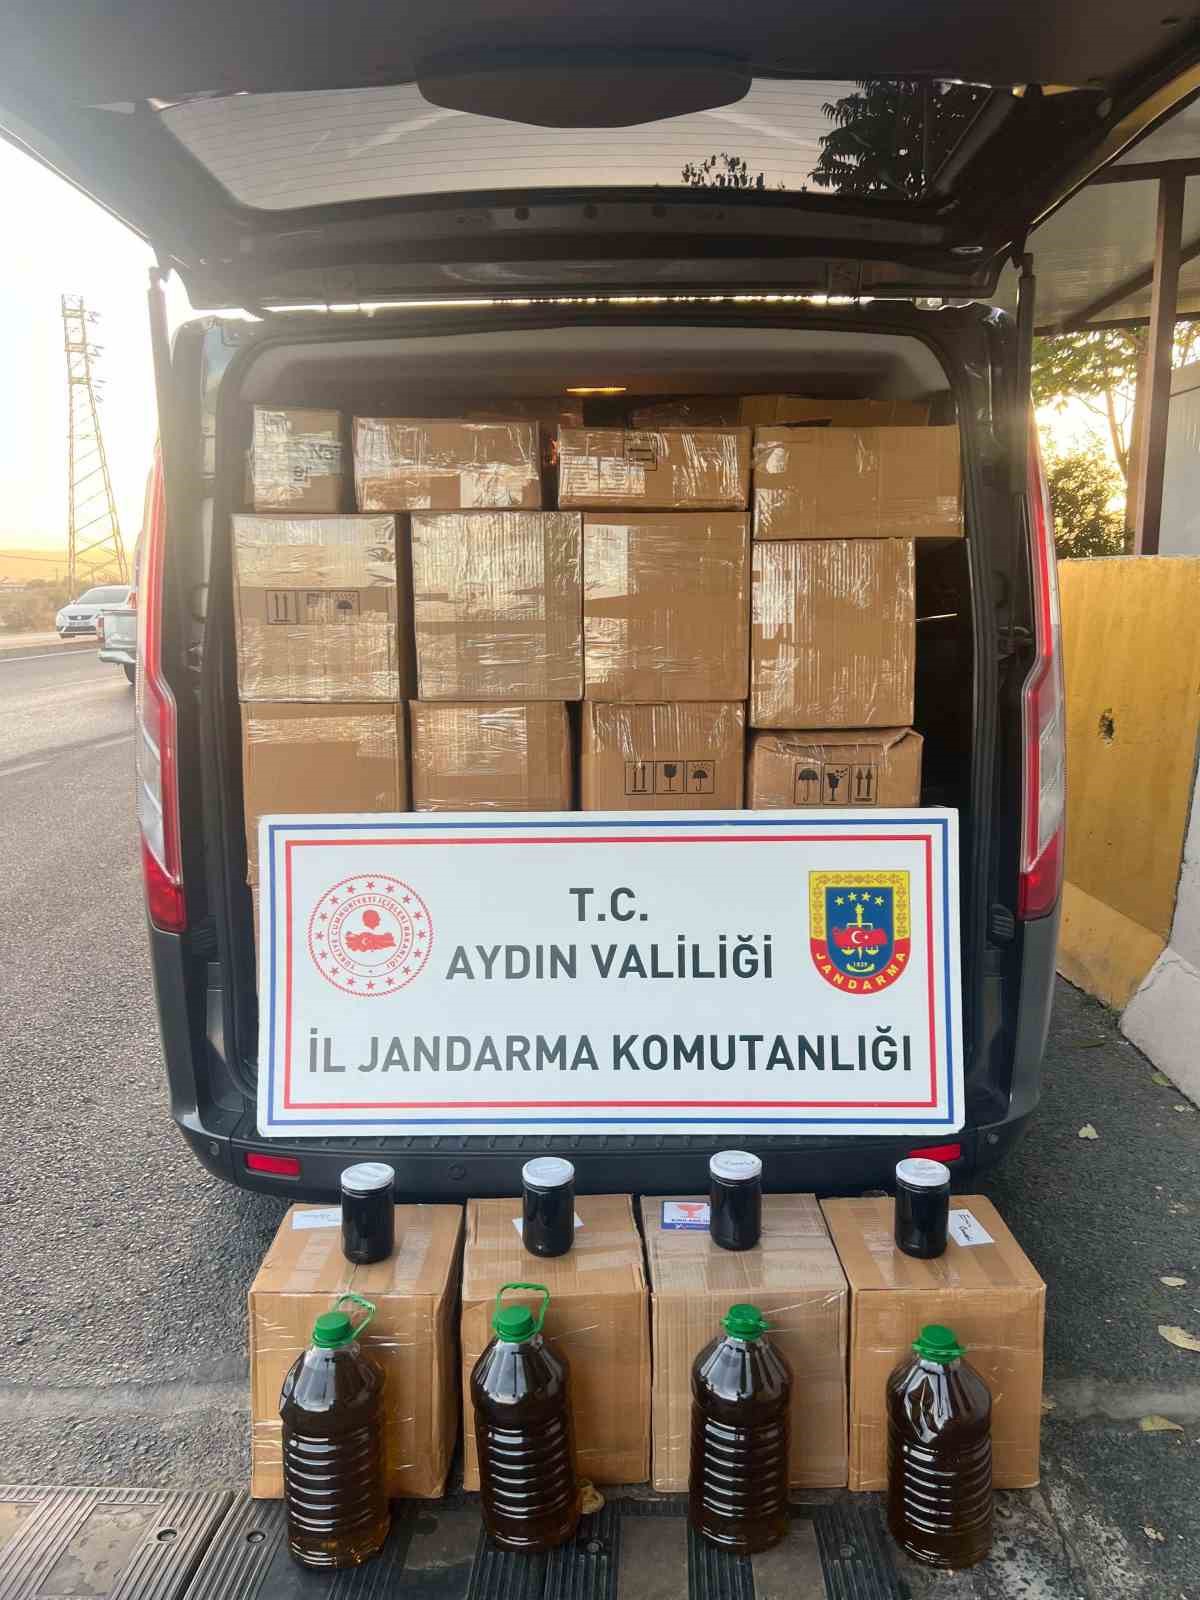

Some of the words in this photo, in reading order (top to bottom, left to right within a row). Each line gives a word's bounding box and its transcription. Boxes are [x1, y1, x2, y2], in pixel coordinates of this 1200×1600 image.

[569, 887, 648, 922] T.C.
[446, 944, 577, 980] AYDIN
[591, 934, 773, 979] VALİLİĞİ
[815, 952, 906, 990] JANDARMA
[310, 1028, 346, 1073] İL
[358, 1035, 600, 1072] JANDARMA
[612, 1026, 912, 1071] KOMUTANLIĞI
